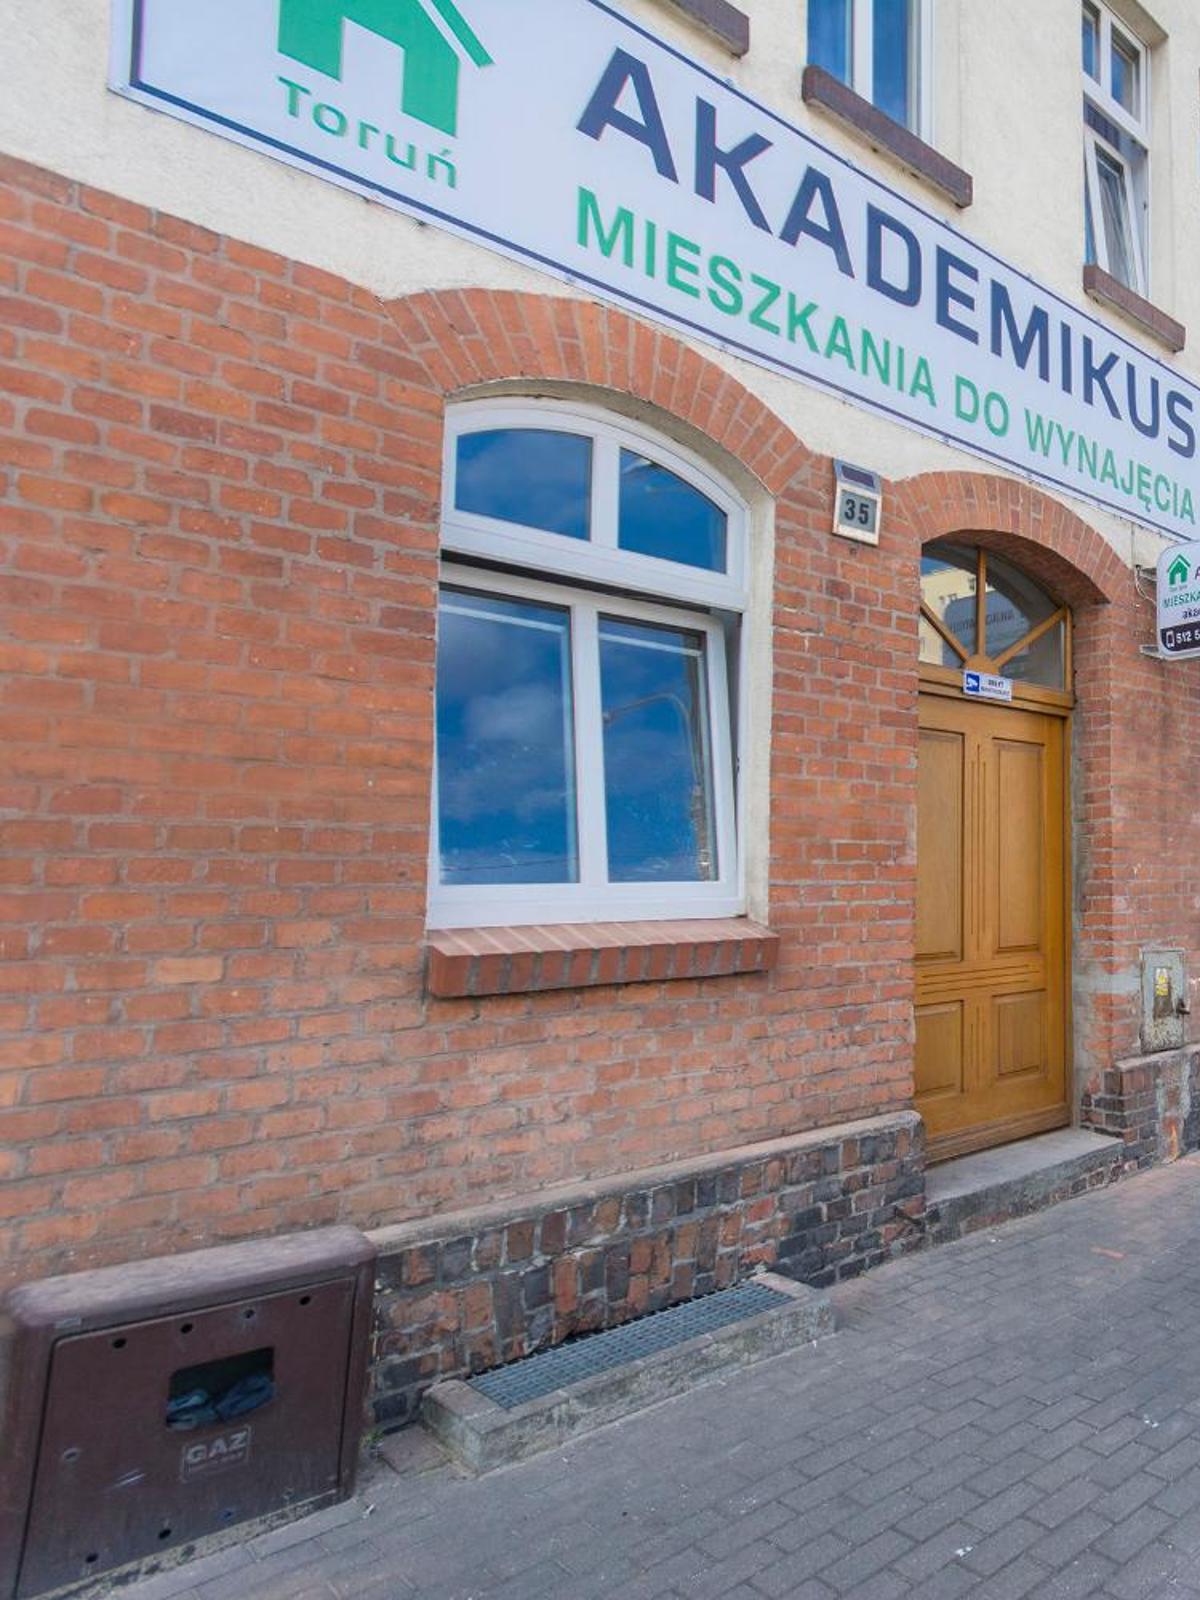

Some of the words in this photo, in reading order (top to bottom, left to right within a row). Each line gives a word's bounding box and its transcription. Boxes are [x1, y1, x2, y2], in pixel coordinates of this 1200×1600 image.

[276, 75, 457, 189] Toruń
[576, 47, 1196, 459] AKADEMIKUS
[576, 186, 937, 407] MIESZKANIA
[954, 375, 1010, 438] DO
[1024, 407, 1196, 526] WYNAJĘCIA
[844, 498, 870, 525] 35
[1175, 630, 1193, 644] 512
[187, 1430, 248, 1464] GAZ
